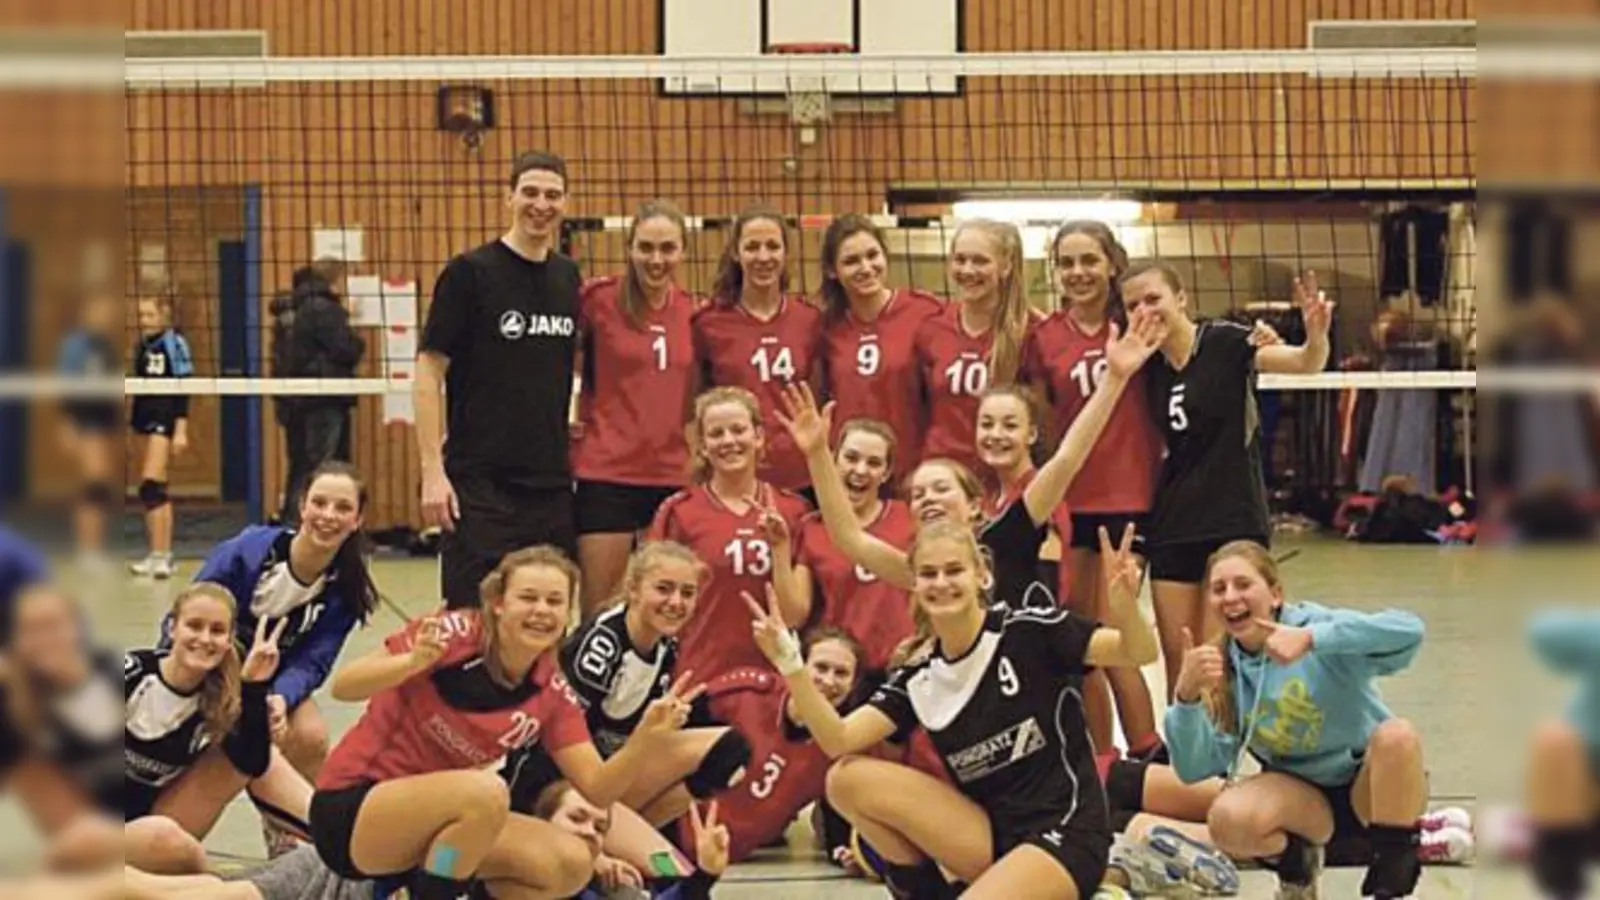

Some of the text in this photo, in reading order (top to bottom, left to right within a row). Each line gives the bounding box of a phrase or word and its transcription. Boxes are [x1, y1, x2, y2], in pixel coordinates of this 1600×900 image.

[652, 335, 667, 371] 1
[751, 347, 796, 382] 14
[857, 343, 880, 376] 9
[945, 359, 988, 396] 10
[1168, 394, 1188, 431] 5
[724, 539, 772, 576] 13
[998, 656, 1019, 696] 9
[750, 761, 780, 799] 3
